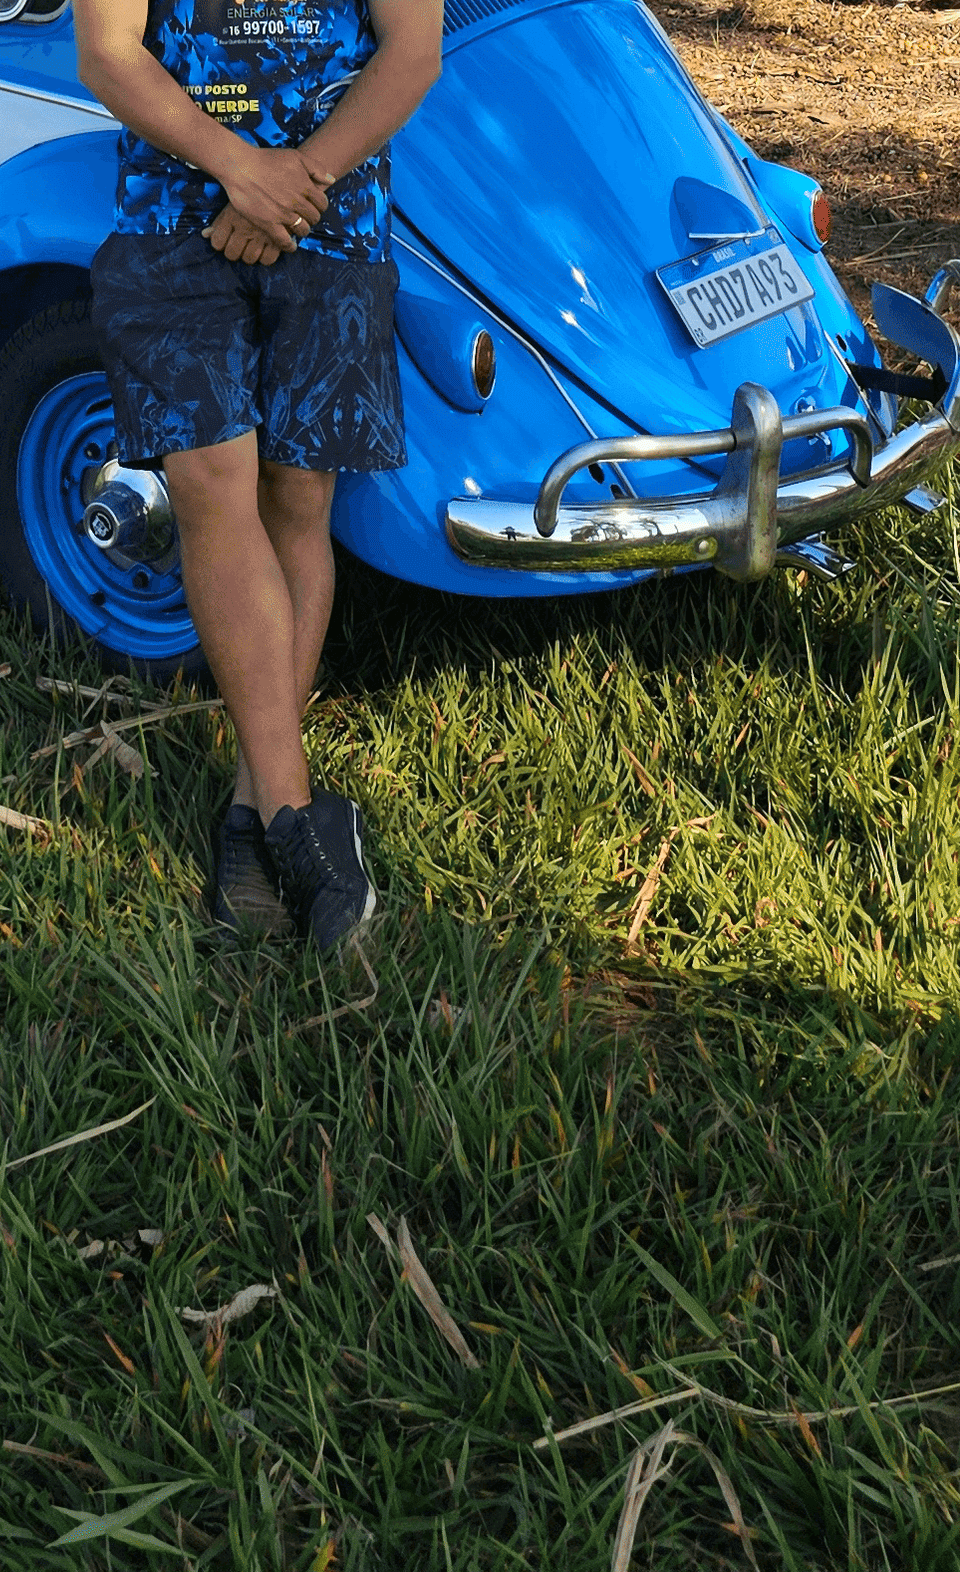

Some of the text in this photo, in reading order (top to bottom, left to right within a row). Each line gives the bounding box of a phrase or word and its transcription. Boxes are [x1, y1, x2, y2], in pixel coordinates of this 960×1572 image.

[227, 7, 316, 19] ENERGIA SOLAR
[229, 20, 321, 36] 16 99700-1597
[182, 84, 248, 96] UTO POSTO
[205, 99, 260, 113] VERDE
[686, 252, 798, 331] CHD7A93
